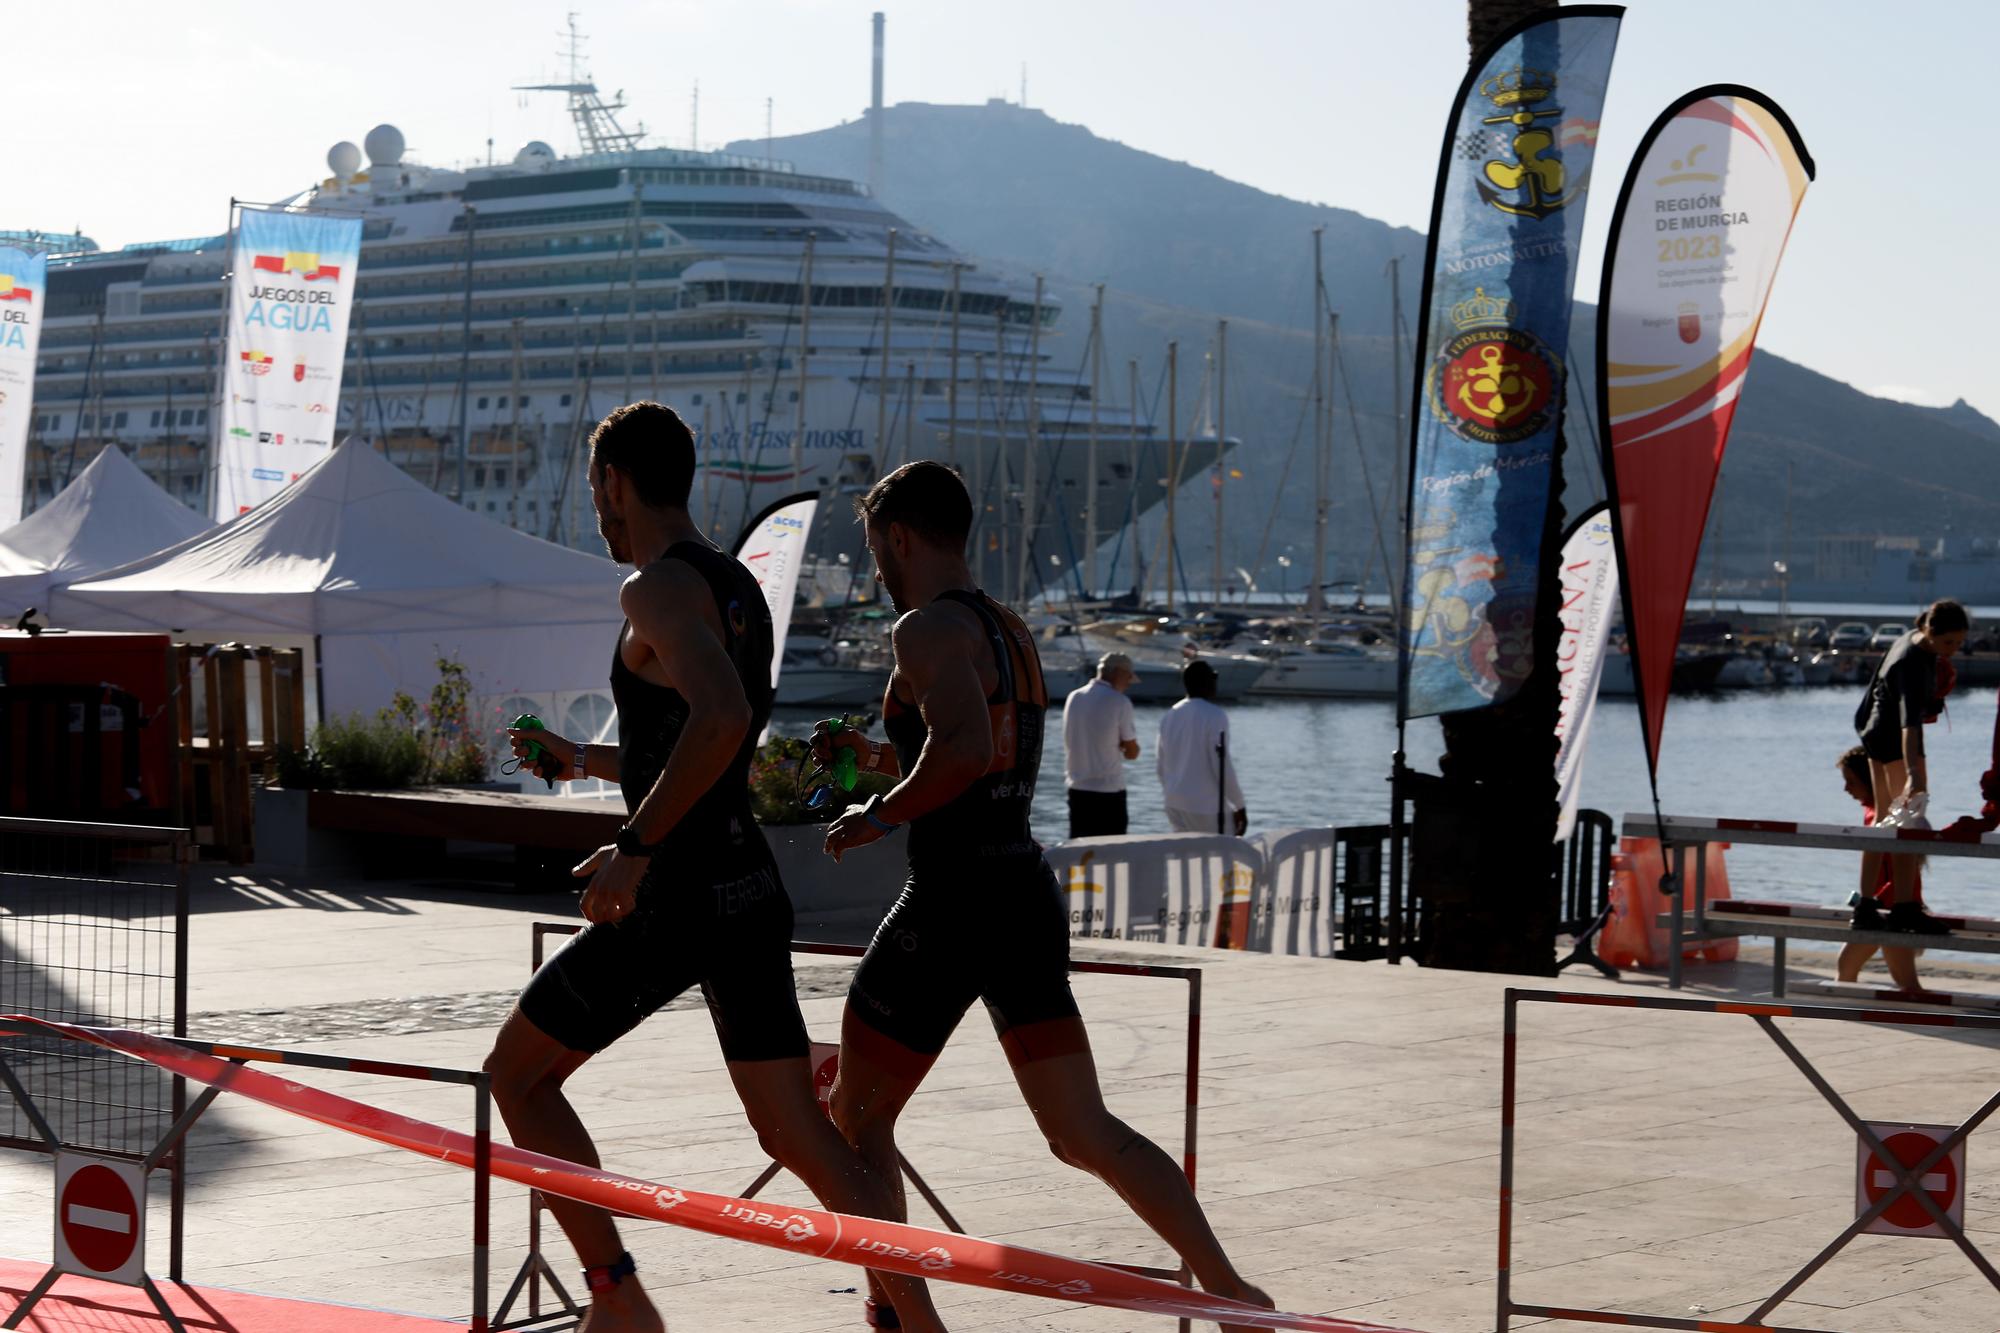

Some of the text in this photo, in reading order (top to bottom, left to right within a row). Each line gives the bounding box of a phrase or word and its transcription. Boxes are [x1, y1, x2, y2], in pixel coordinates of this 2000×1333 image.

[1655, 193, 1721, 213] REGIÓN
[1656, 211, 1749, 232] DE MURCIA
[1657, 234, 1722, 263] 2023
[249, 286, 336, 305] JUEGOS DEL
[4, 309, 30, 325] DEL
[244, 301, 332, 333] AGUA
[750, 421, 864, 449] Fascnosa
[773, 515, 803, 528] aces
[1592, 523, 1613, 533] ac
[1158, 905, 1211, 932] Región
